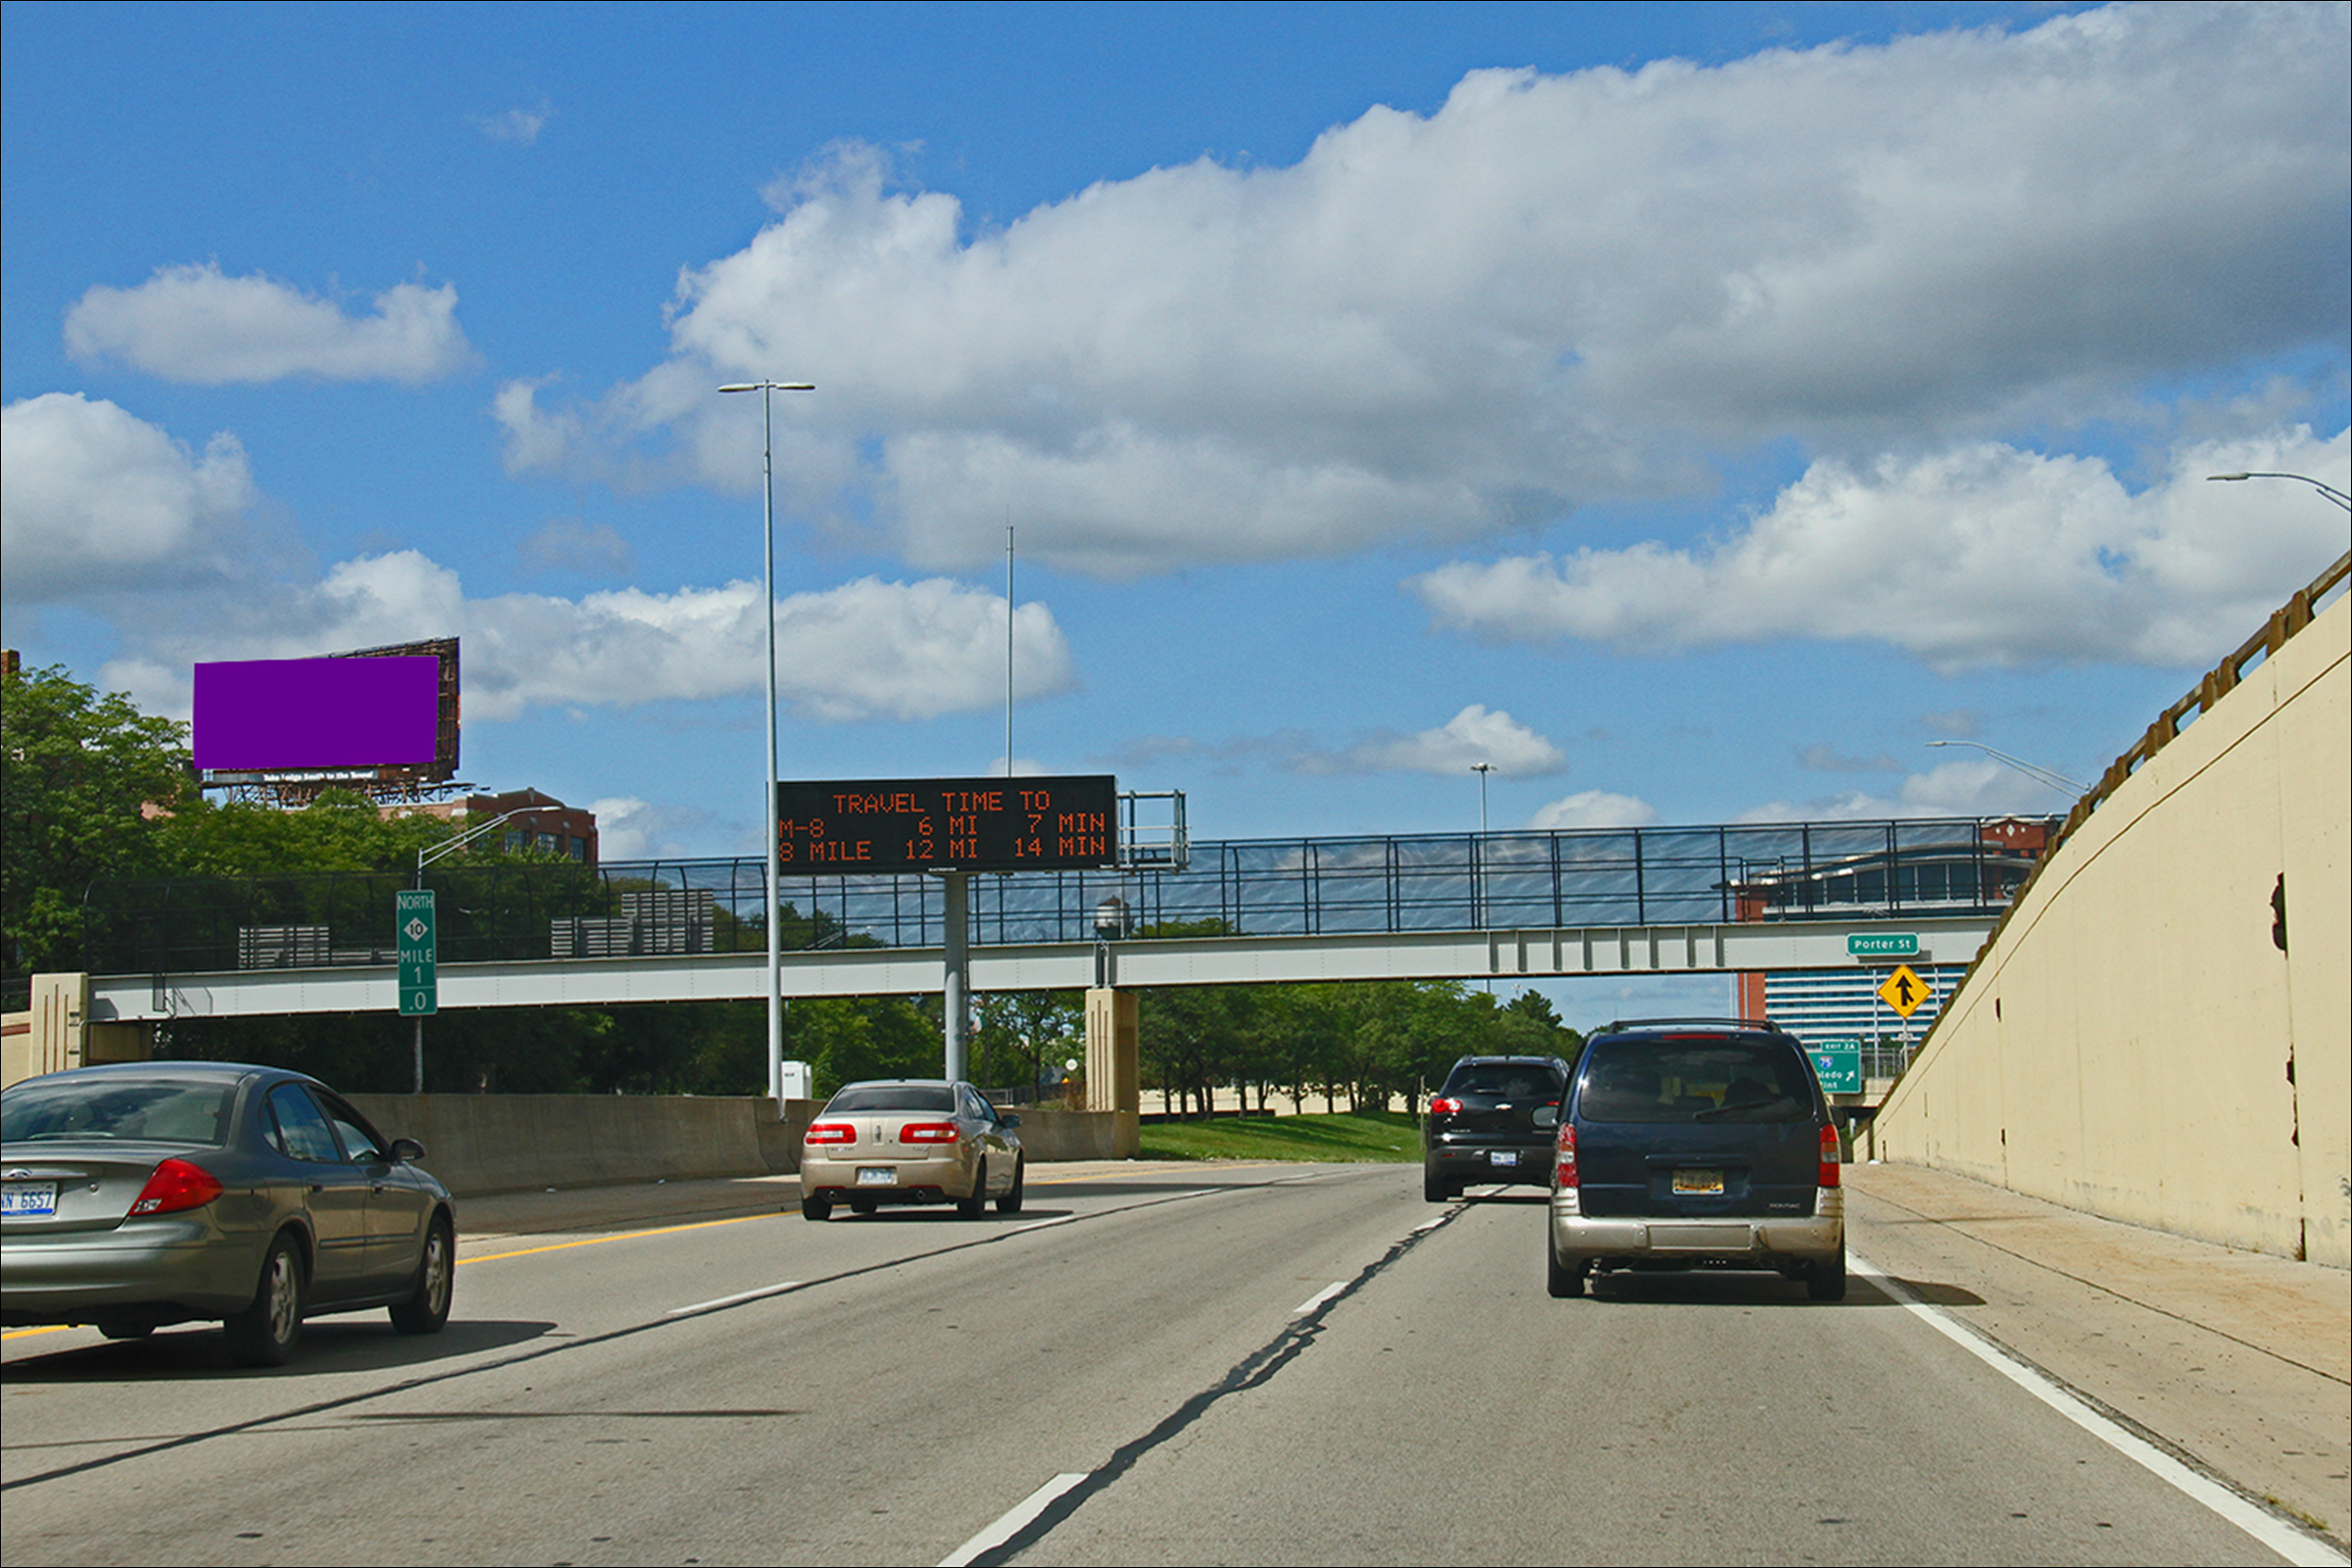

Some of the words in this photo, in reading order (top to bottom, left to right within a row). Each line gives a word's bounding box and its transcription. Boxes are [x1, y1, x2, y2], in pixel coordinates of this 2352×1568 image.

[325, 771, 335, 780] to
[335, 771, 350, 780] the
[832, 793, 926, 814] TRAVEL
[941, 791, 1004, 812] TIME
[1018, 790, 1052, 811] TO
[778, 817, 825, 839] M-8
[917, 815, 934, 837] 6
[949, 815, 978, 836] MI
[1027, 813, 1044, 834] 7
[1057, 812, 1106, 834] MIN
[778, 841, 795, 862] 8
[808, 840, 872, 861] MILE
[906, 839, 935, 860] 12
[949, 838, 978, 859] MI
[1014, 837, 1044, 858] 14
[1057, 836, 1106, 857] MIN
[397, 895, 434, 910] NORTH
[409, 922, 424, 935] 10
[1853, 939, 1893, 950] Porter
[1897, 938, 1912, 950] St
[400, 949, 433, 964] MILE
[414, 965, 421, 985] 1
[1843, 1042, 1856, 1051] 2A
[1817, 1070, 1843, 1080] oledo
[20, 1190, 53, 1209] 6657
